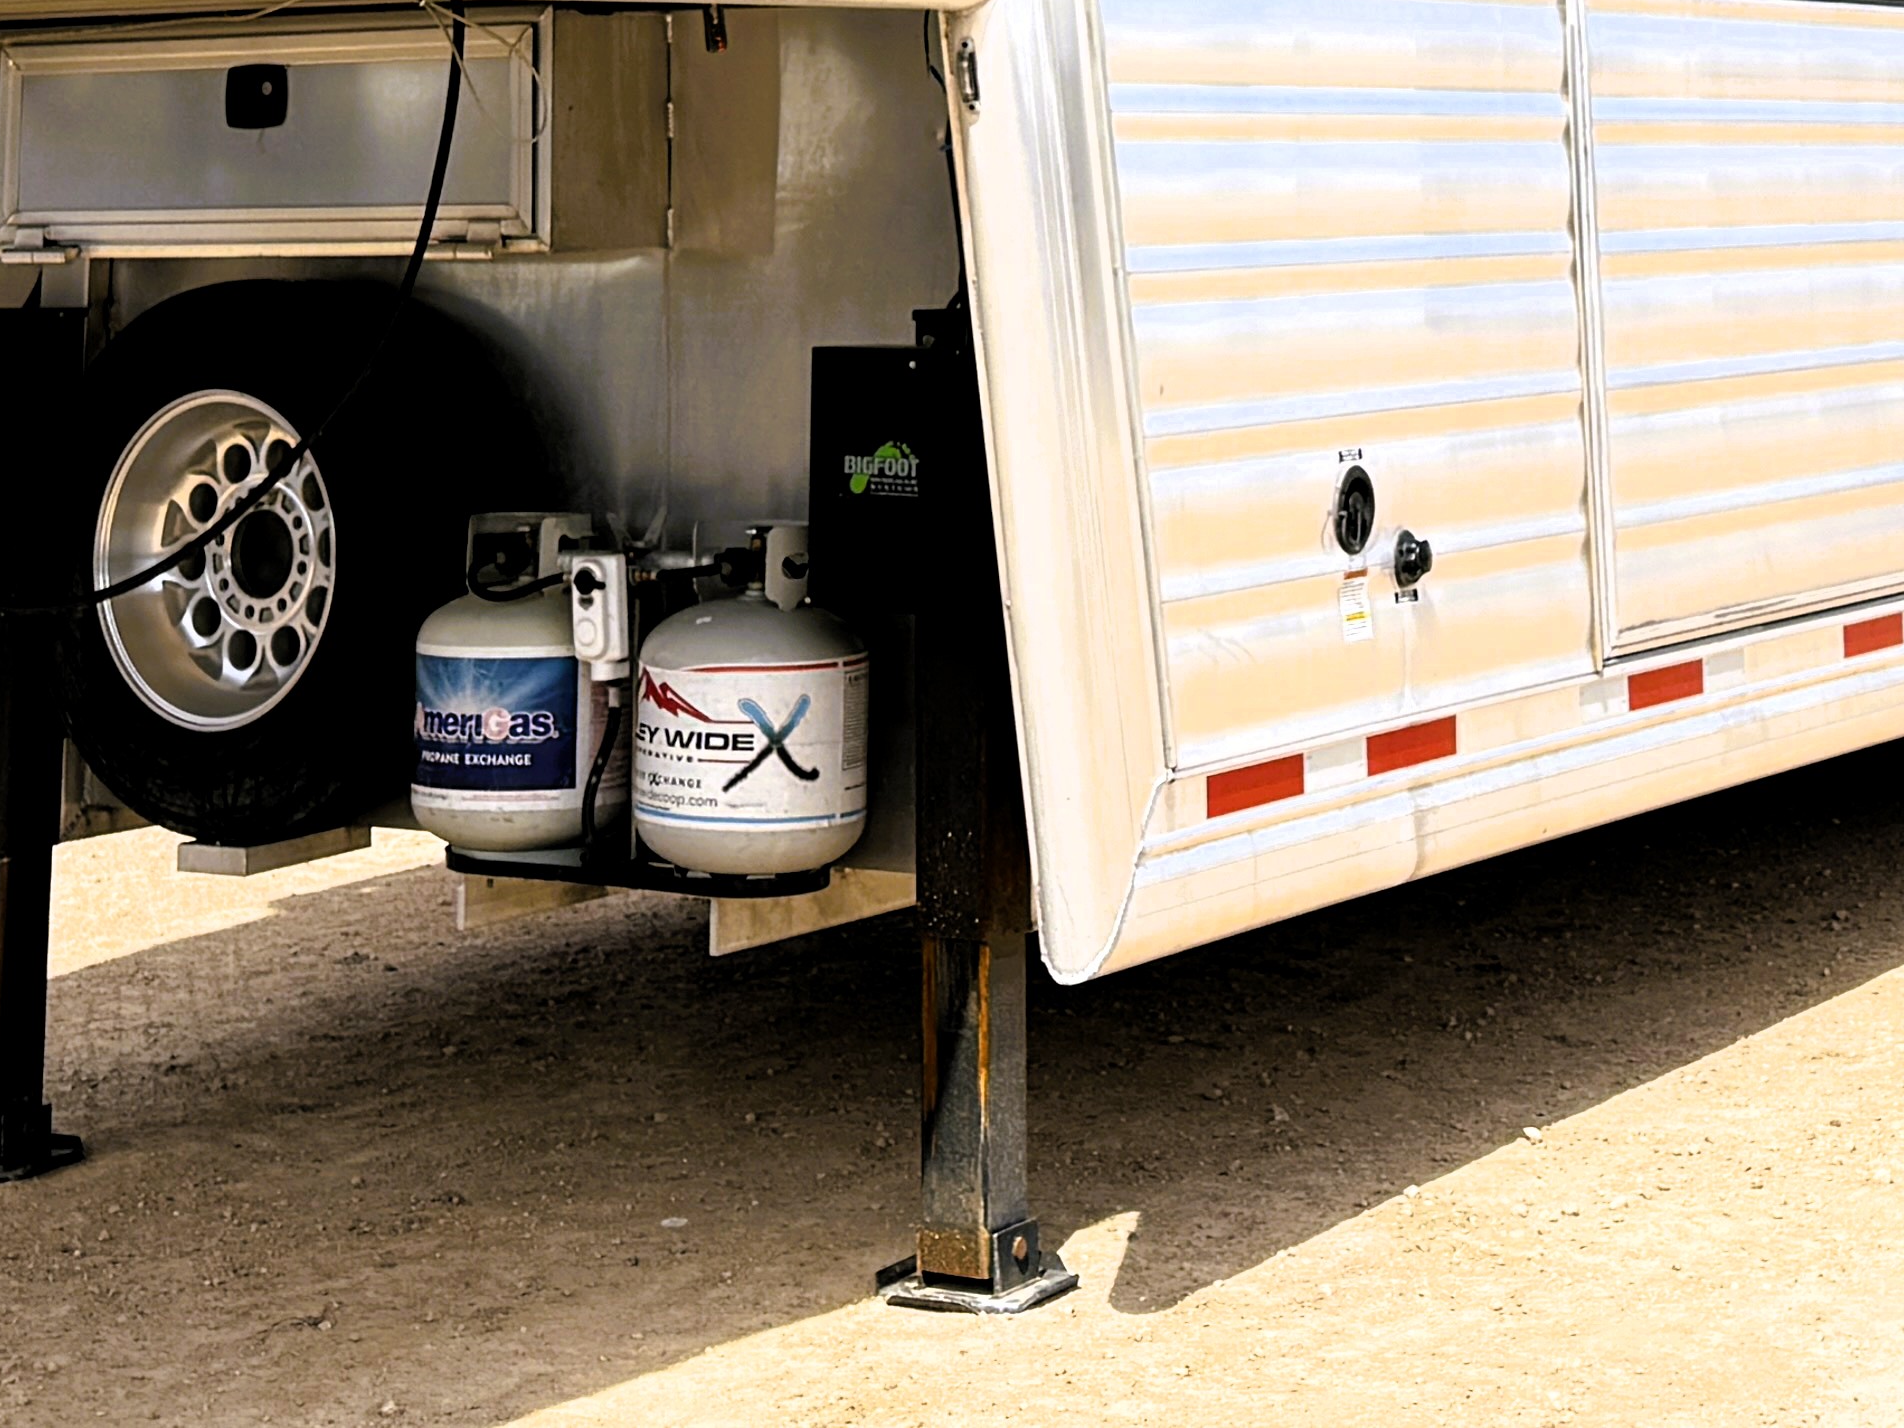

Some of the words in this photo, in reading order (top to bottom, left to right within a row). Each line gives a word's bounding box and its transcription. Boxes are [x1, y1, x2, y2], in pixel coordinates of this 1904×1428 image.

[844, 455, 920, 477] BIGFOOT
[664, 728, 755, 751] WIDE
[464, 753, 532, 766] EXCHANGE
